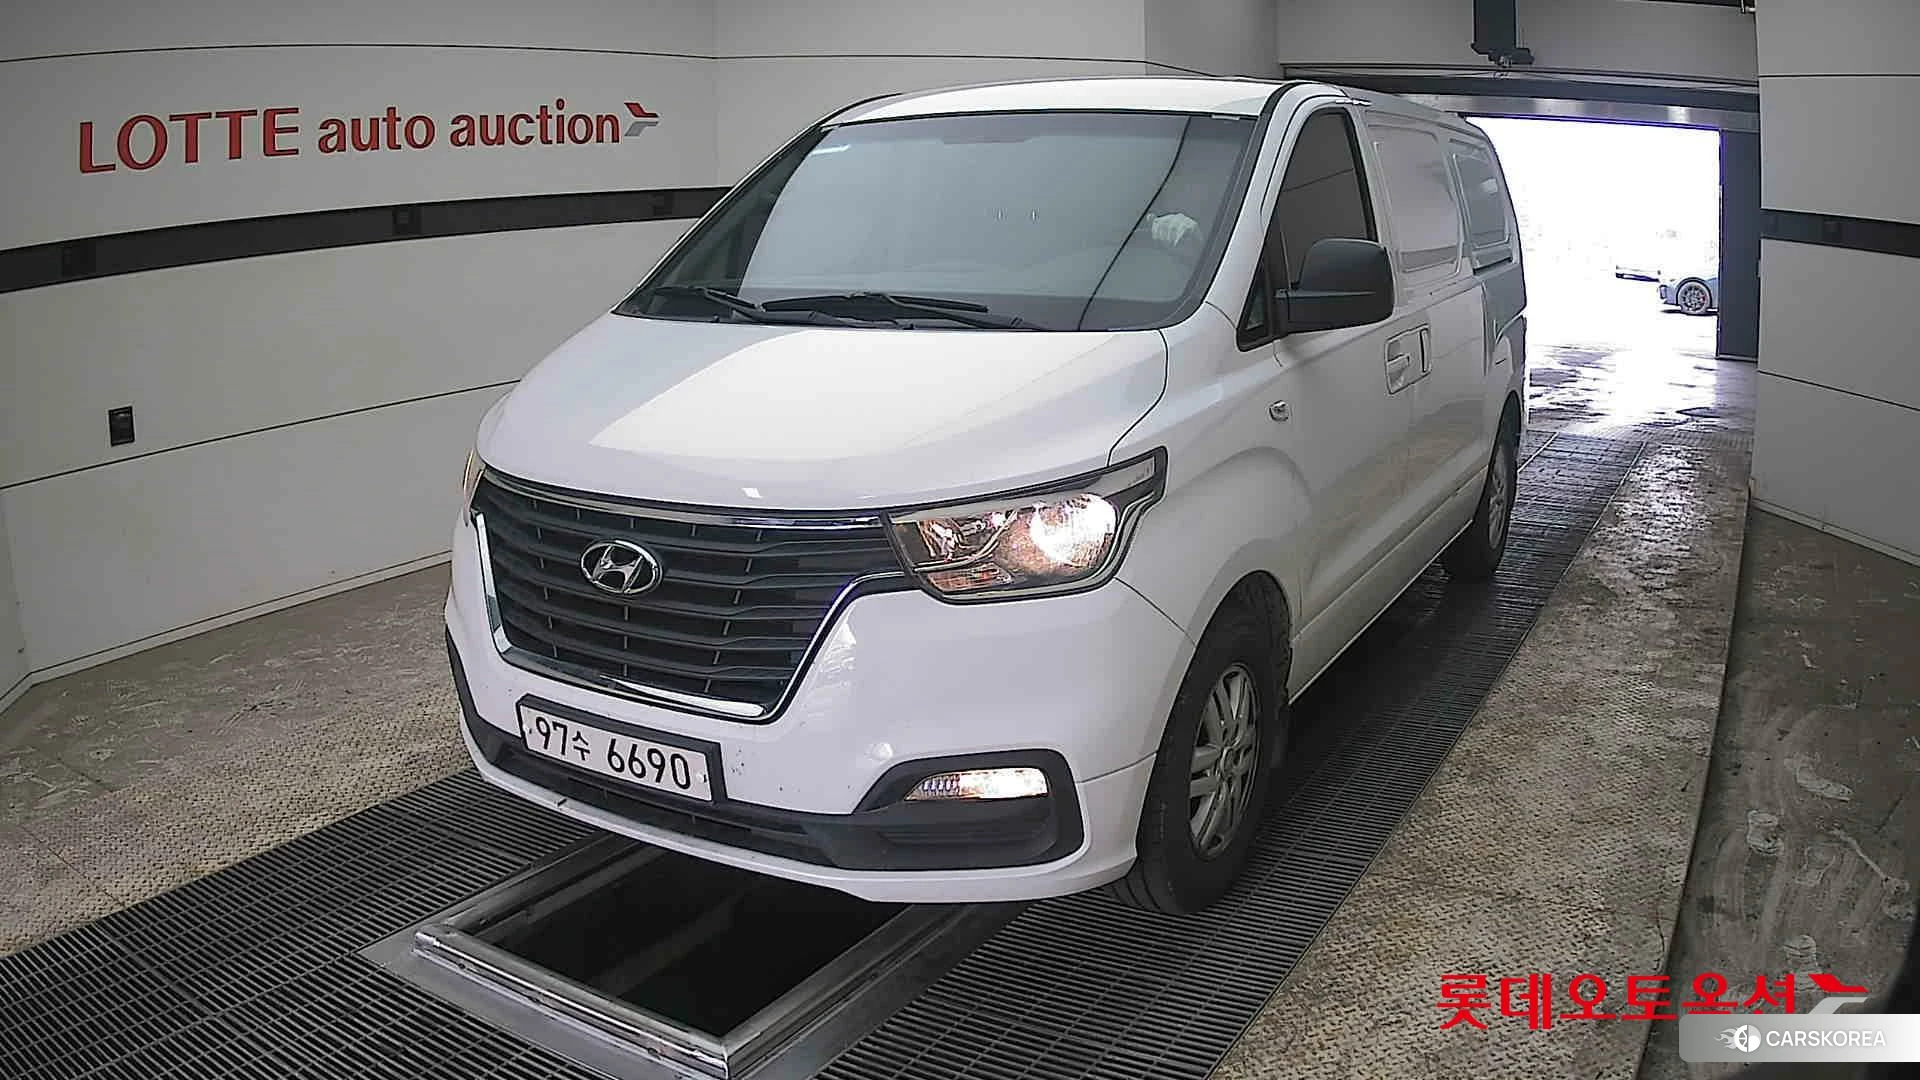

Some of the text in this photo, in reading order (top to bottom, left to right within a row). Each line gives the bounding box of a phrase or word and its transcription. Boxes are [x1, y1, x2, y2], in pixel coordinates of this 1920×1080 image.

[79, 98, 620, 173] LOTTE auto auction
[607, 738, 691, 790] 6690
